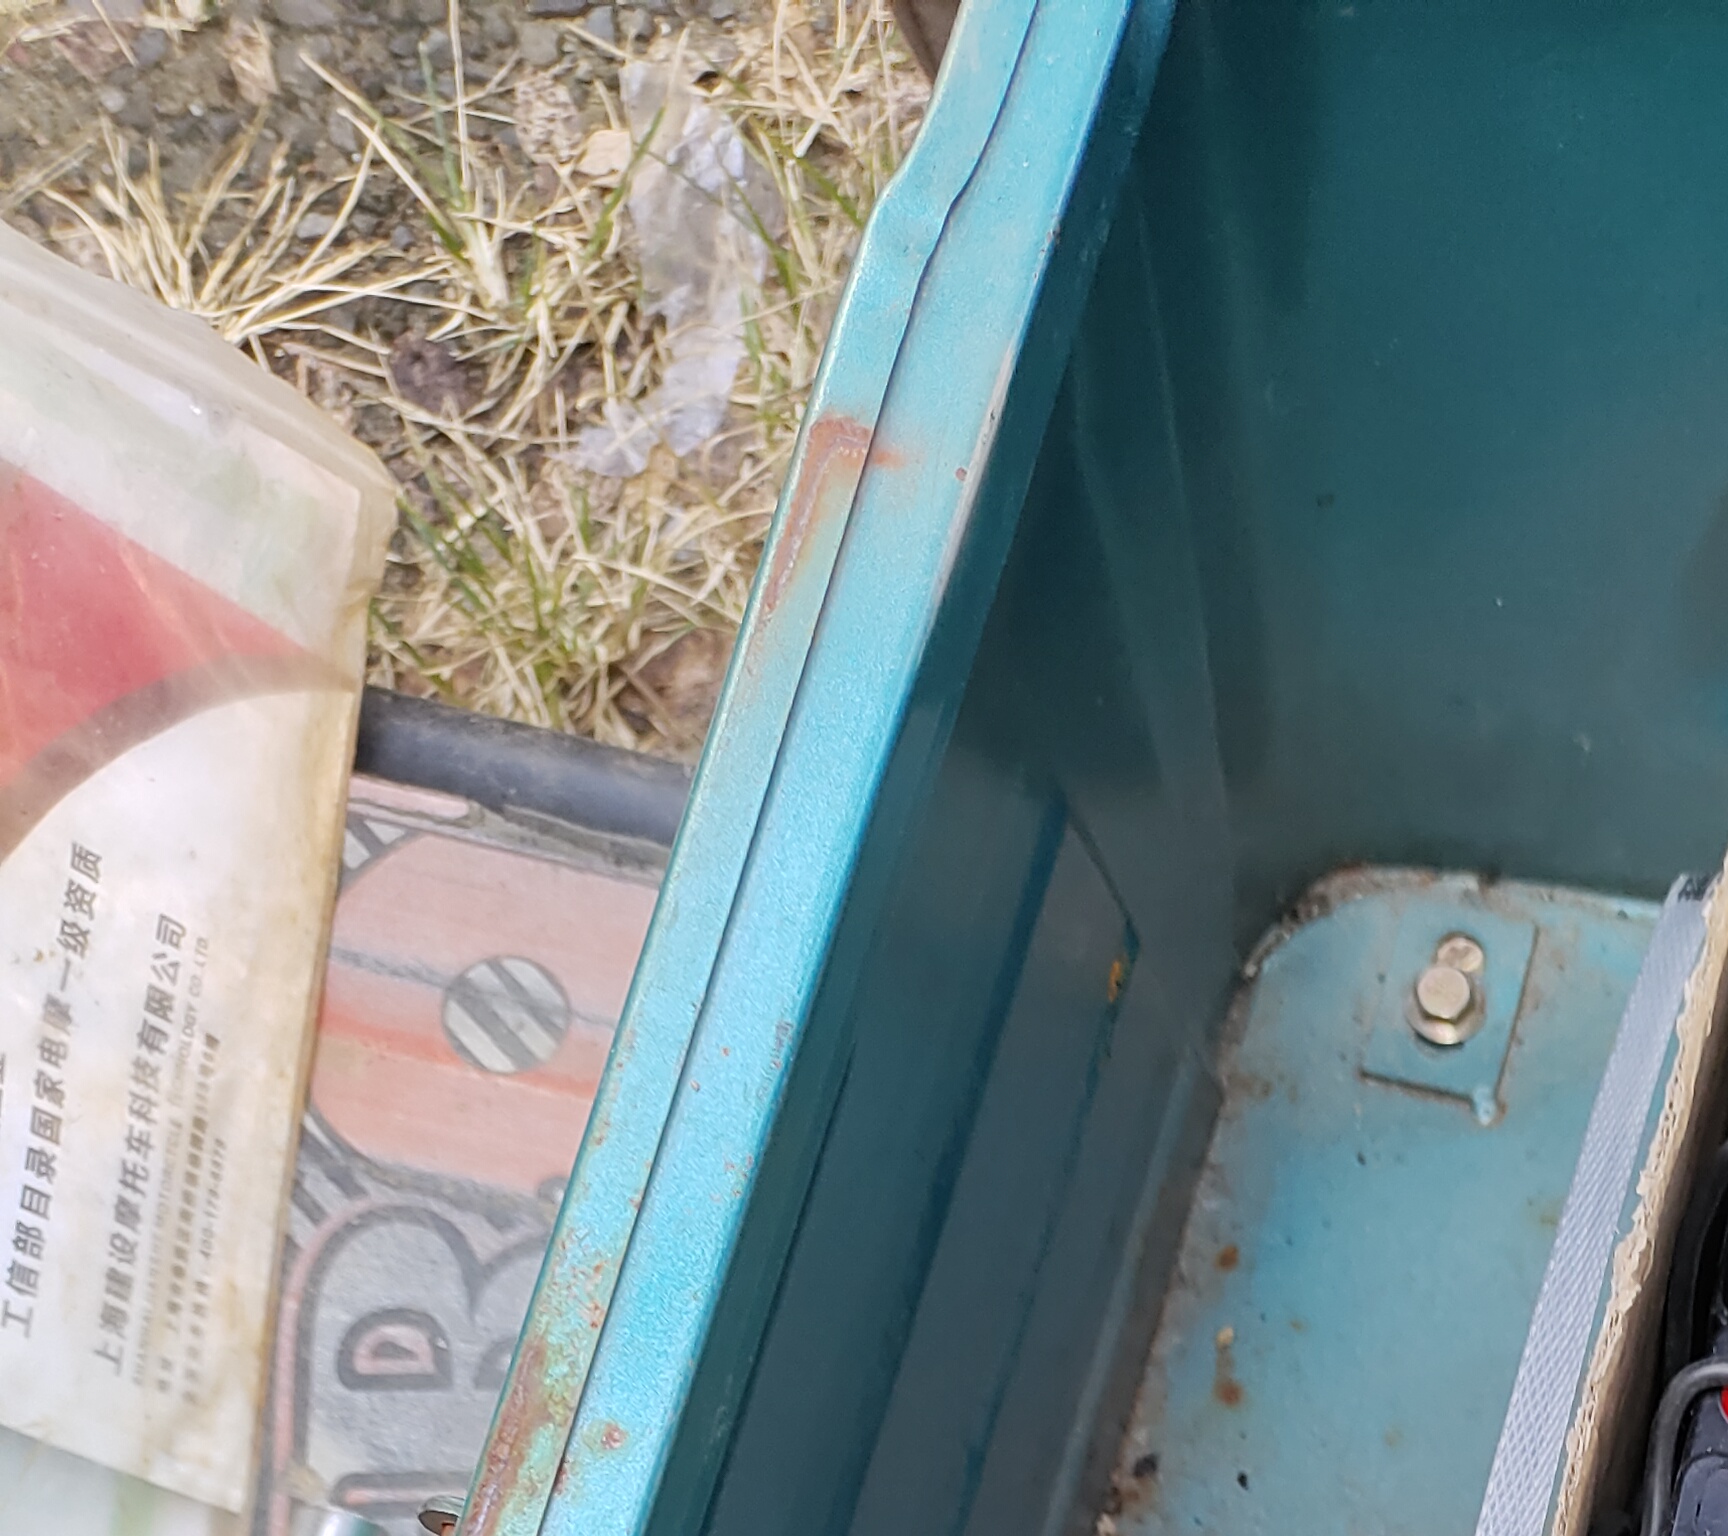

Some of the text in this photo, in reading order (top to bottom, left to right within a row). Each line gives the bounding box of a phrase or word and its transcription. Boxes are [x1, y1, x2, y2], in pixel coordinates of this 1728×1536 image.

[1, 842, 102, 1338] 工信部目录国家电摩一级资质
[93, 913, 187, 1376] 上海建设摩托车科技有限公司
